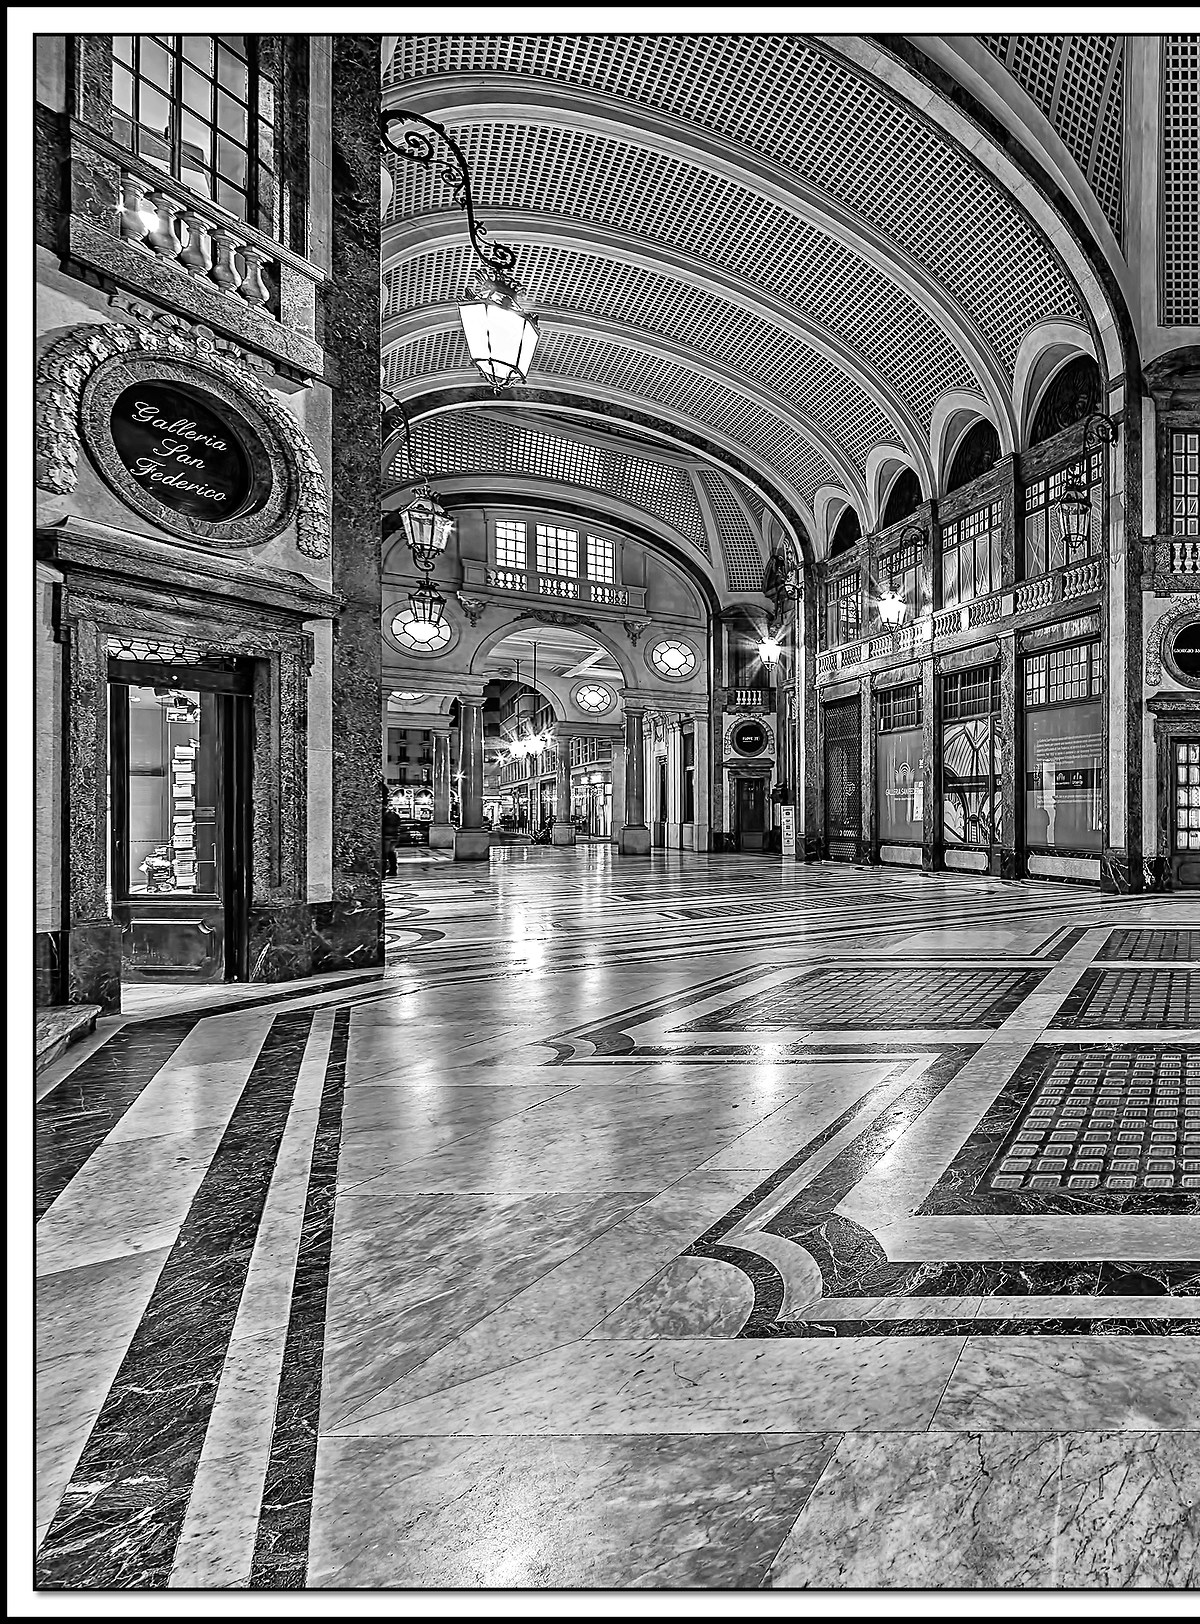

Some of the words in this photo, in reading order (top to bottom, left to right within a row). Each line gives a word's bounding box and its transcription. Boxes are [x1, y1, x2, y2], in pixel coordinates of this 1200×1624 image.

[131, 401, 227, 451] Galleria
[152, 438, 205, 469] San
[130, 457, 227, 501] Federico
